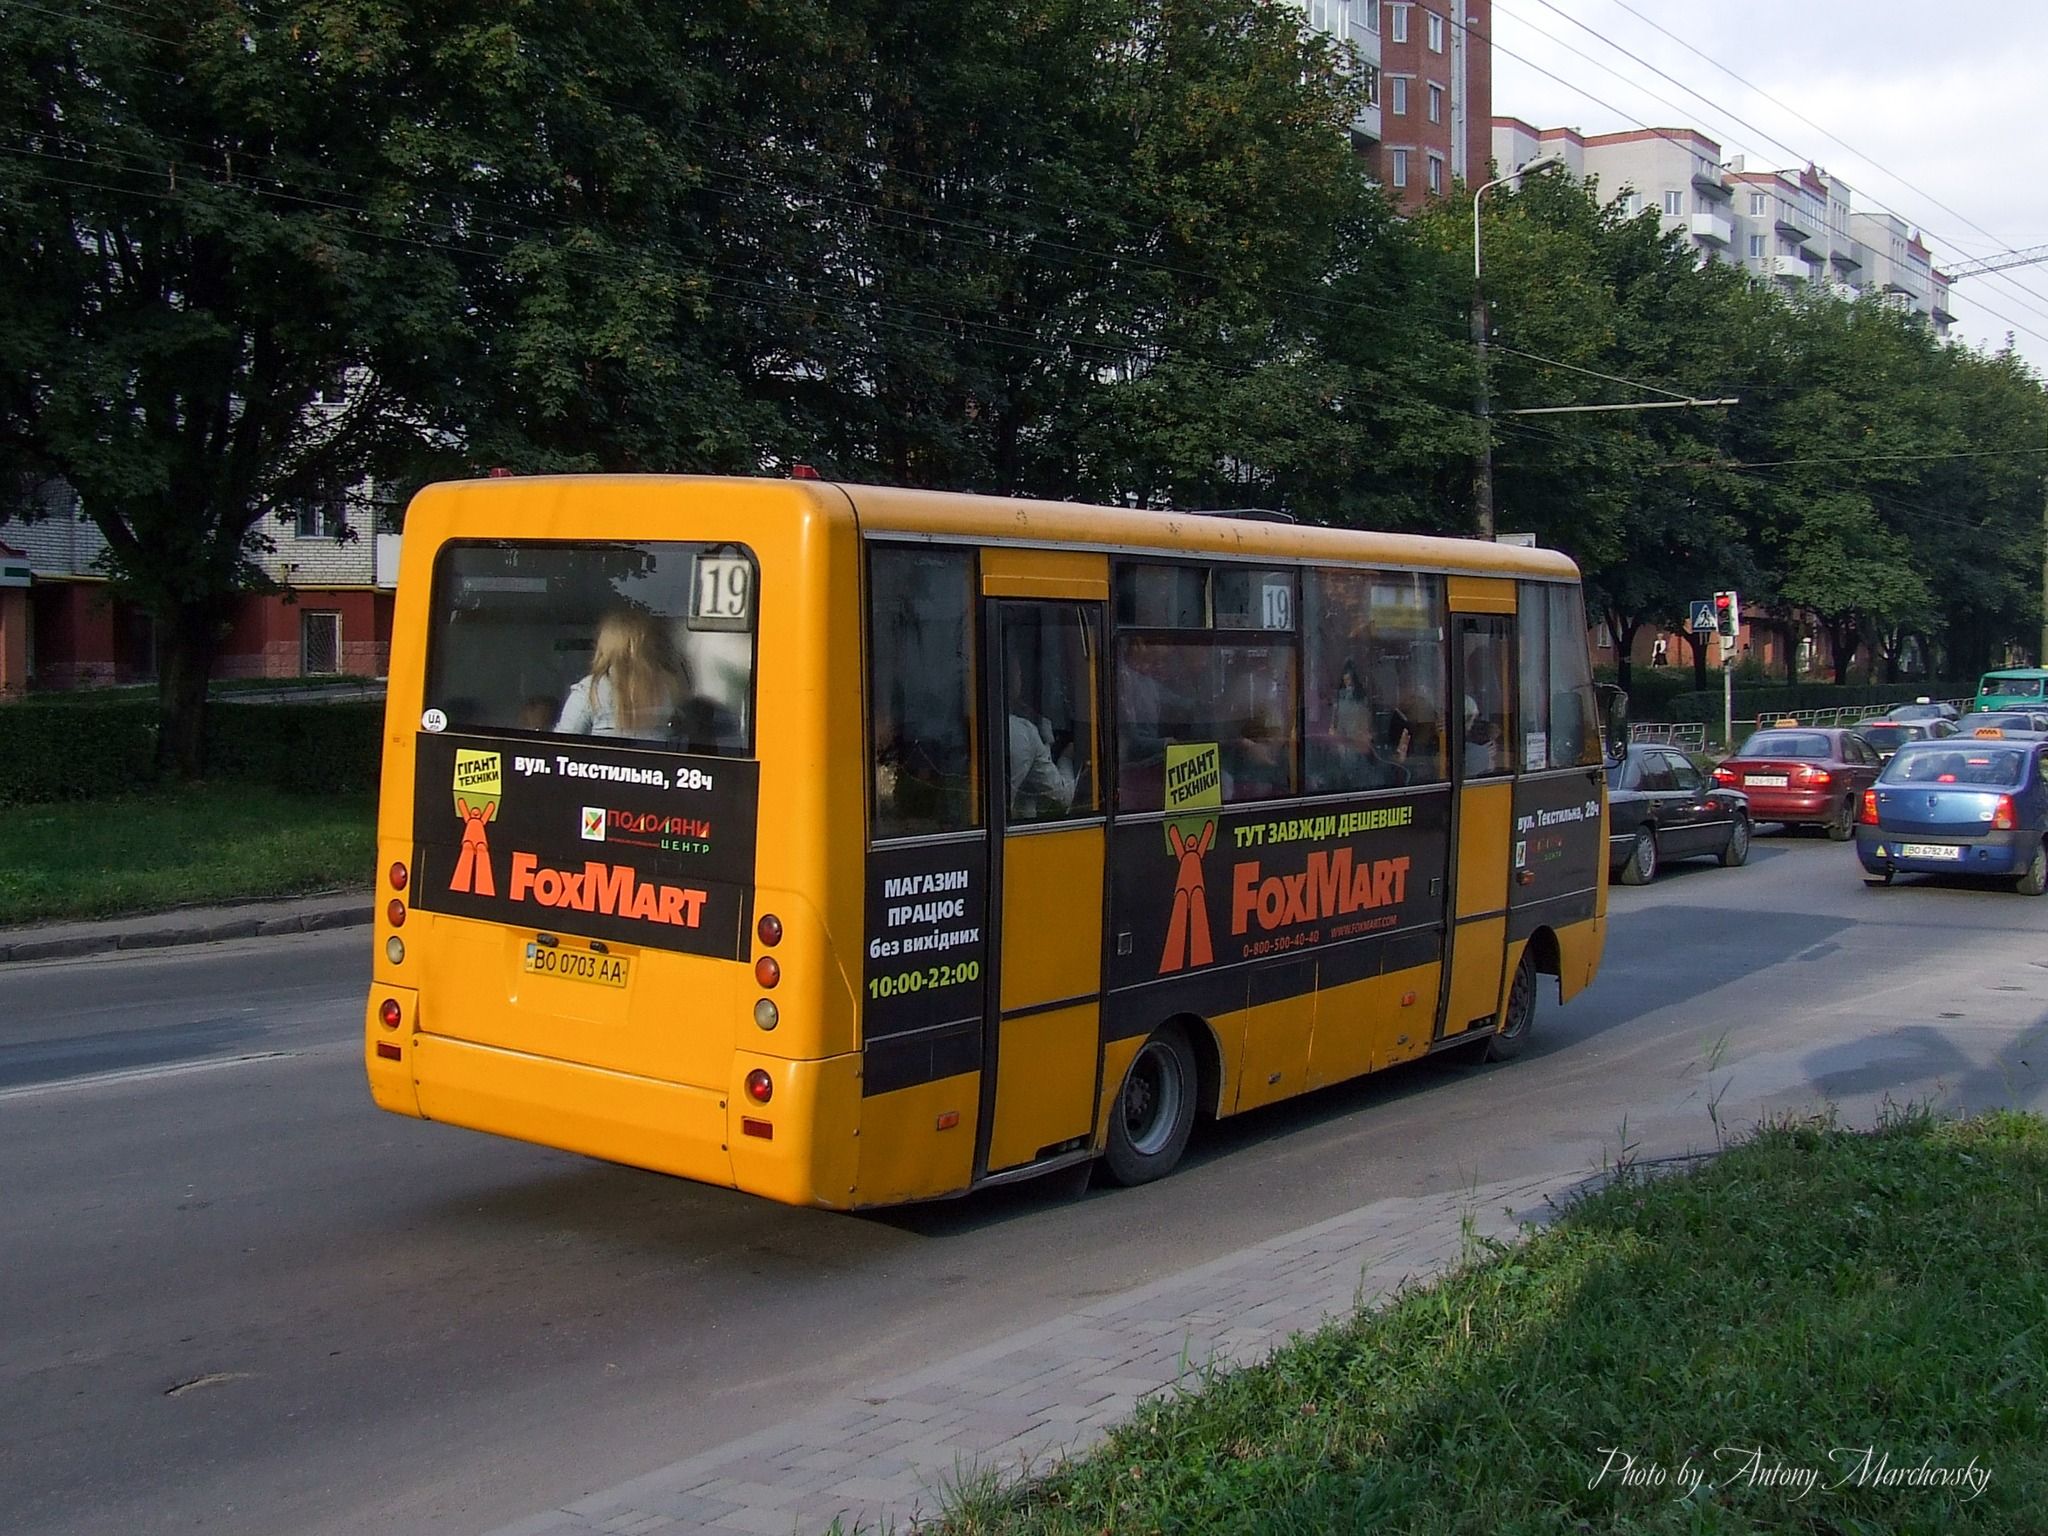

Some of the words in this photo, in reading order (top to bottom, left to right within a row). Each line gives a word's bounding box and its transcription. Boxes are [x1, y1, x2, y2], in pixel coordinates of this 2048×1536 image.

[706, 565, 748, 616] 19
[1266, 588, 1289, 629] 19
[428, 714, 441, 724] UA
[457, 756, 497, 776] ГІГАНТ
[459, 771, 499, 787] ТЕХНІКИ
[514, 756, 551, 777] вул.
[556, 756, 670, 790] Текстильна,
[676, 768, 713, 791] 28ч
[1168, 749, 1215, 788] ГІГАНТ
[1170, 770, 1218, 805] ТЕХНІКИ
[606, 809, 711, 838] ПОДОЛЯНИ
[1234, 824, 1266, 848] ТУТ
[1268, 815, 1336, 844] ЗАВЖДИ
[1338, 806, 1413, 837] ДЕШЕВШЕ!
[661, 839, 710, 854] ЦЕНТР
[884, 870, 968, 898] МАГАЗИН
[887, 898, 964, 927] ПРАЦЮЄ
[869, 937, 900, 959] без
[903, 928, 979, 953] вихідних
[1242, 929, 1320, 958] 0-800-500-40-40
[535, 949, 556, 971] BO
[560, 953, 595, 978] 0703
[599, 959, 621, 983] AA
[868, 960, 980, 999] 10:00-22:00
